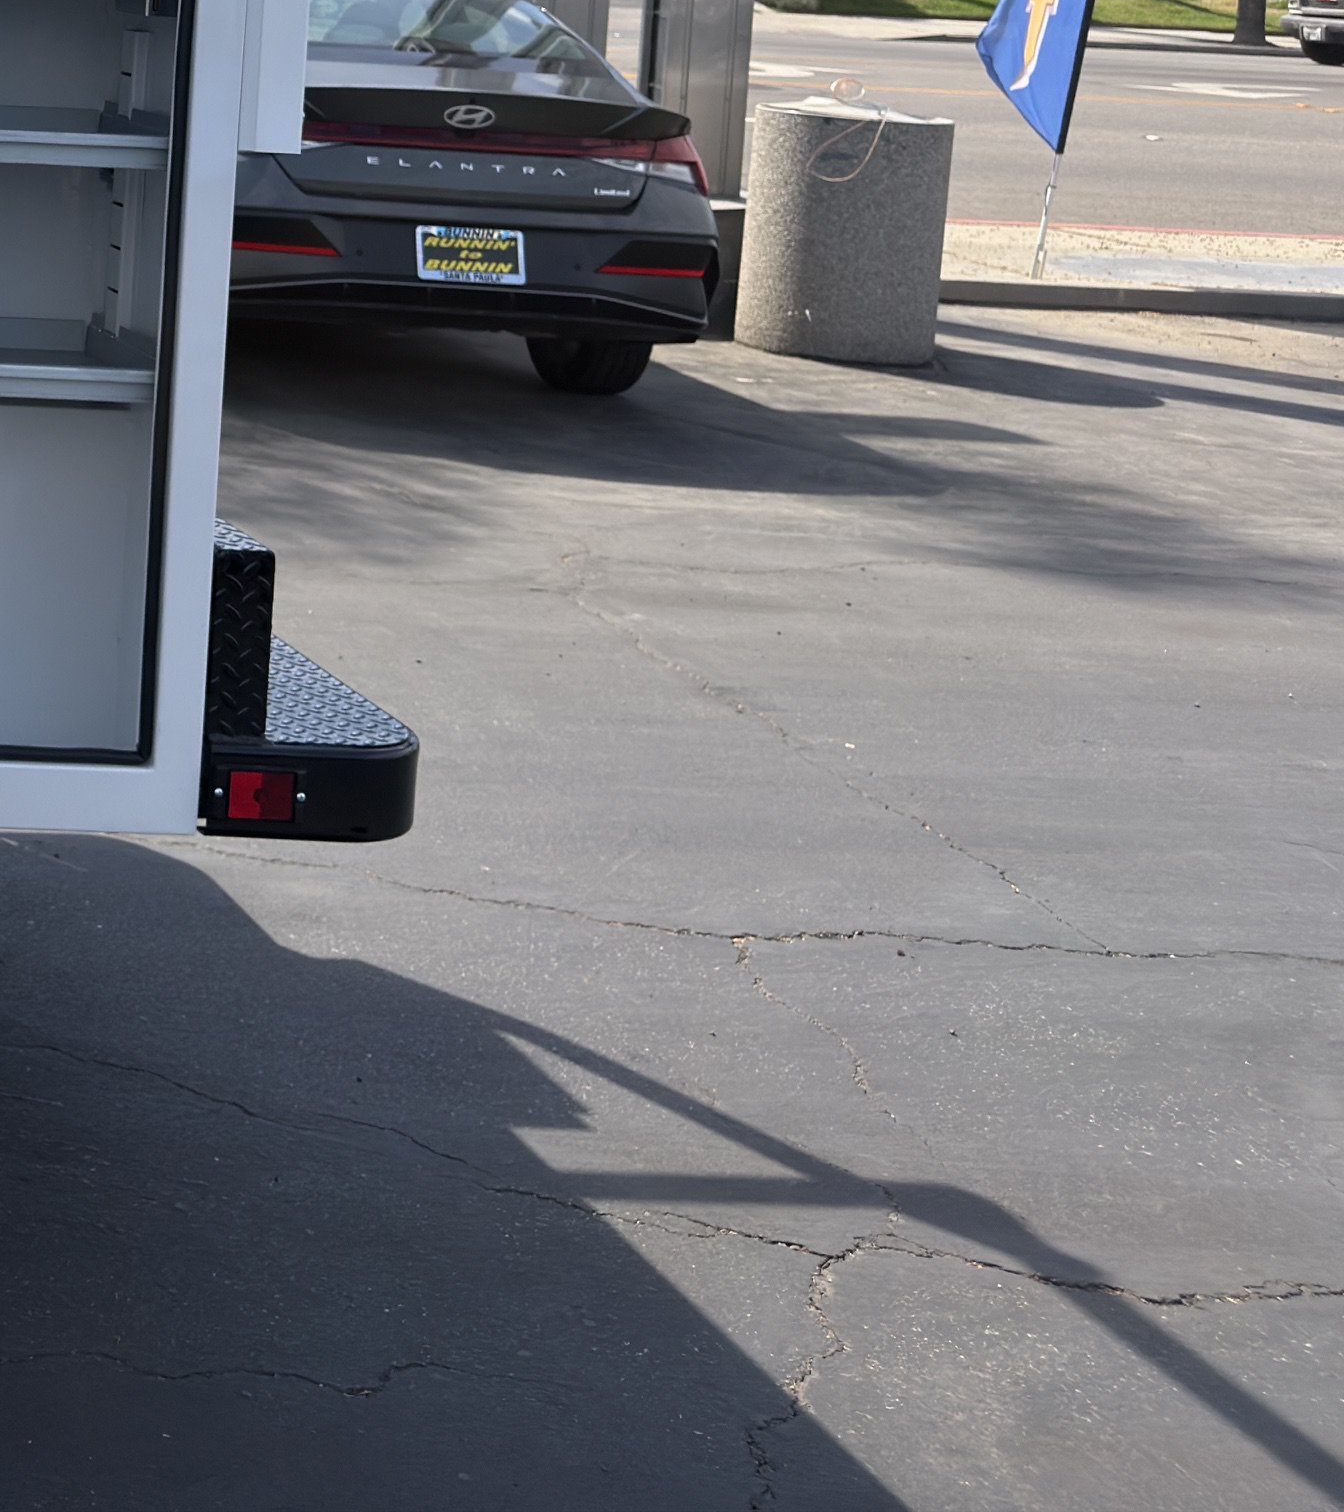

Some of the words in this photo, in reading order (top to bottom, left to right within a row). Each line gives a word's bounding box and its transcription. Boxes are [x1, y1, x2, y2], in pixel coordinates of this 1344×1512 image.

[366, 155, 566, 177] ELANTRA
[459, 249, 483, 260] to
[424, 259, 513, 273] BUNNIN
